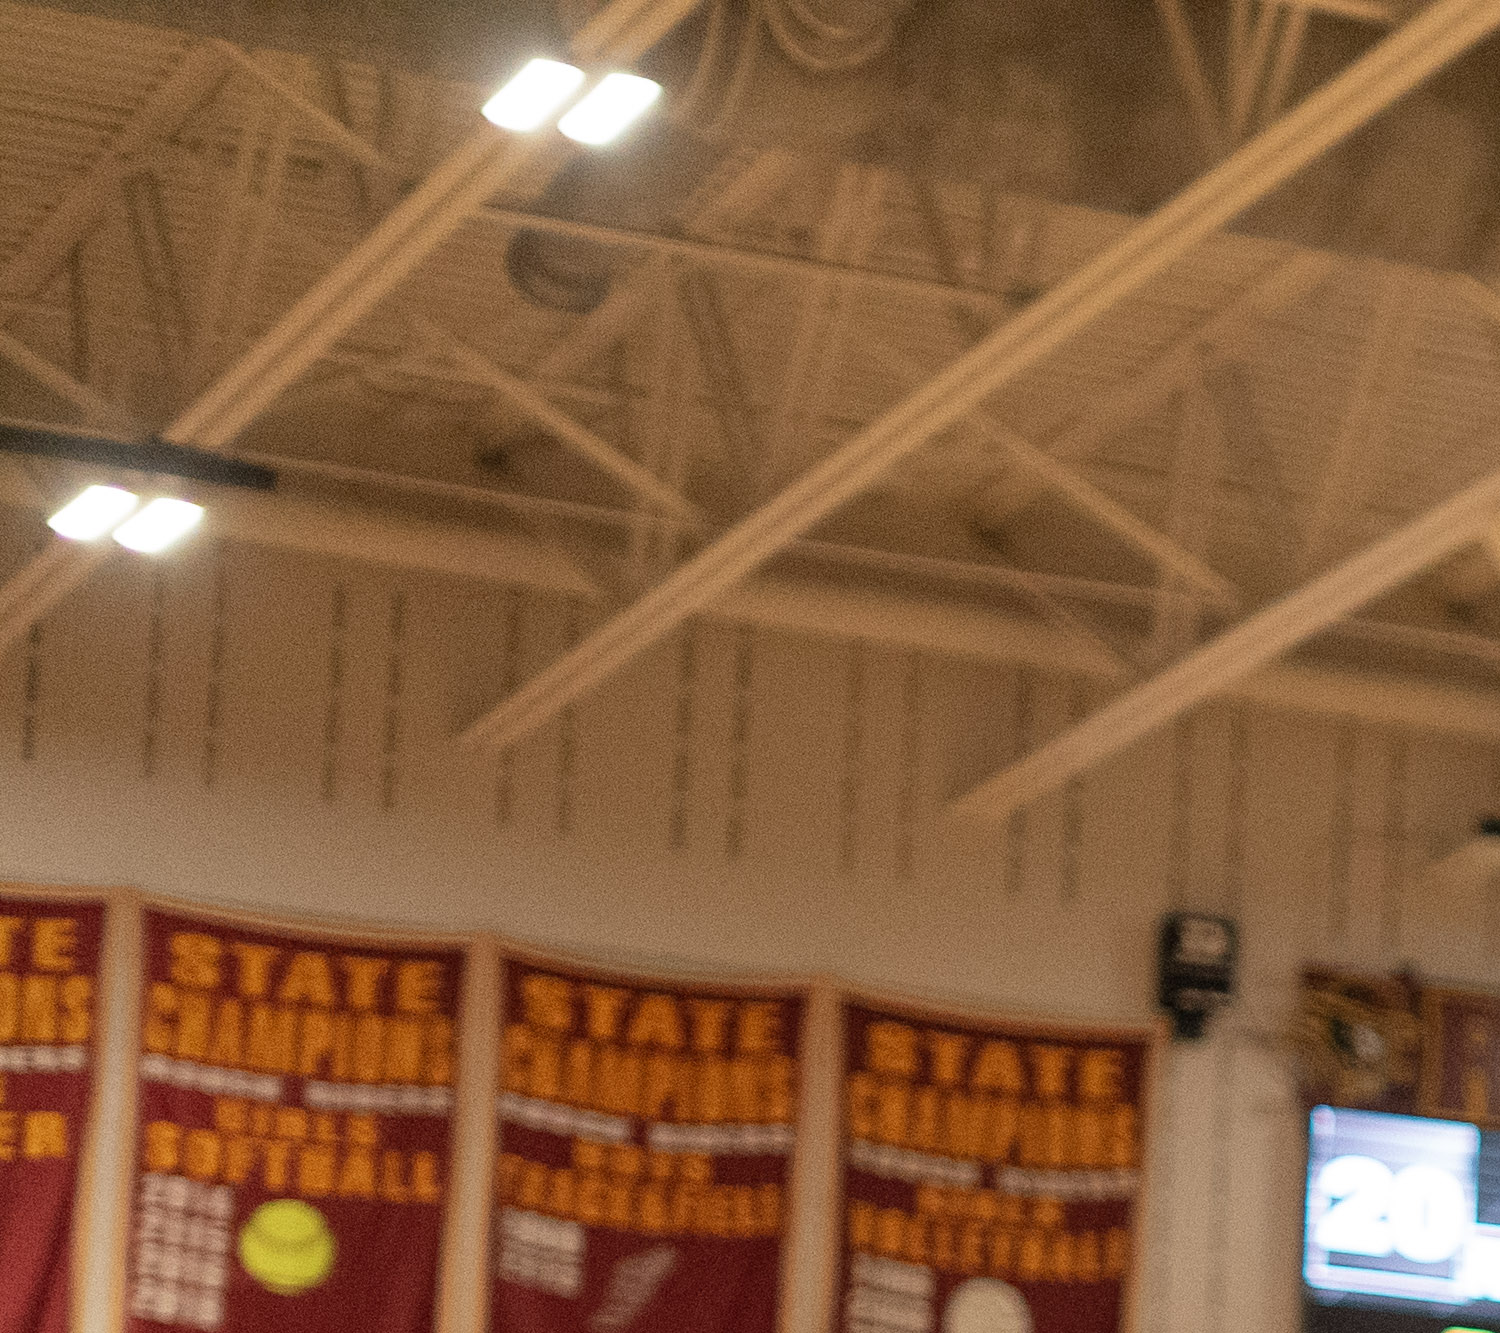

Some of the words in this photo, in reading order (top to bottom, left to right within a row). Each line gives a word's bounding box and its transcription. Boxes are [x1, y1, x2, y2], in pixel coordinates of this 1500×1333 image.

[169, 931, 443, 1013] STATE
[522, 976, 783, 1050] STATE
[866, 1020, 1126, 1098] STATE
[1313, 1155, 1466, 1263] 20
